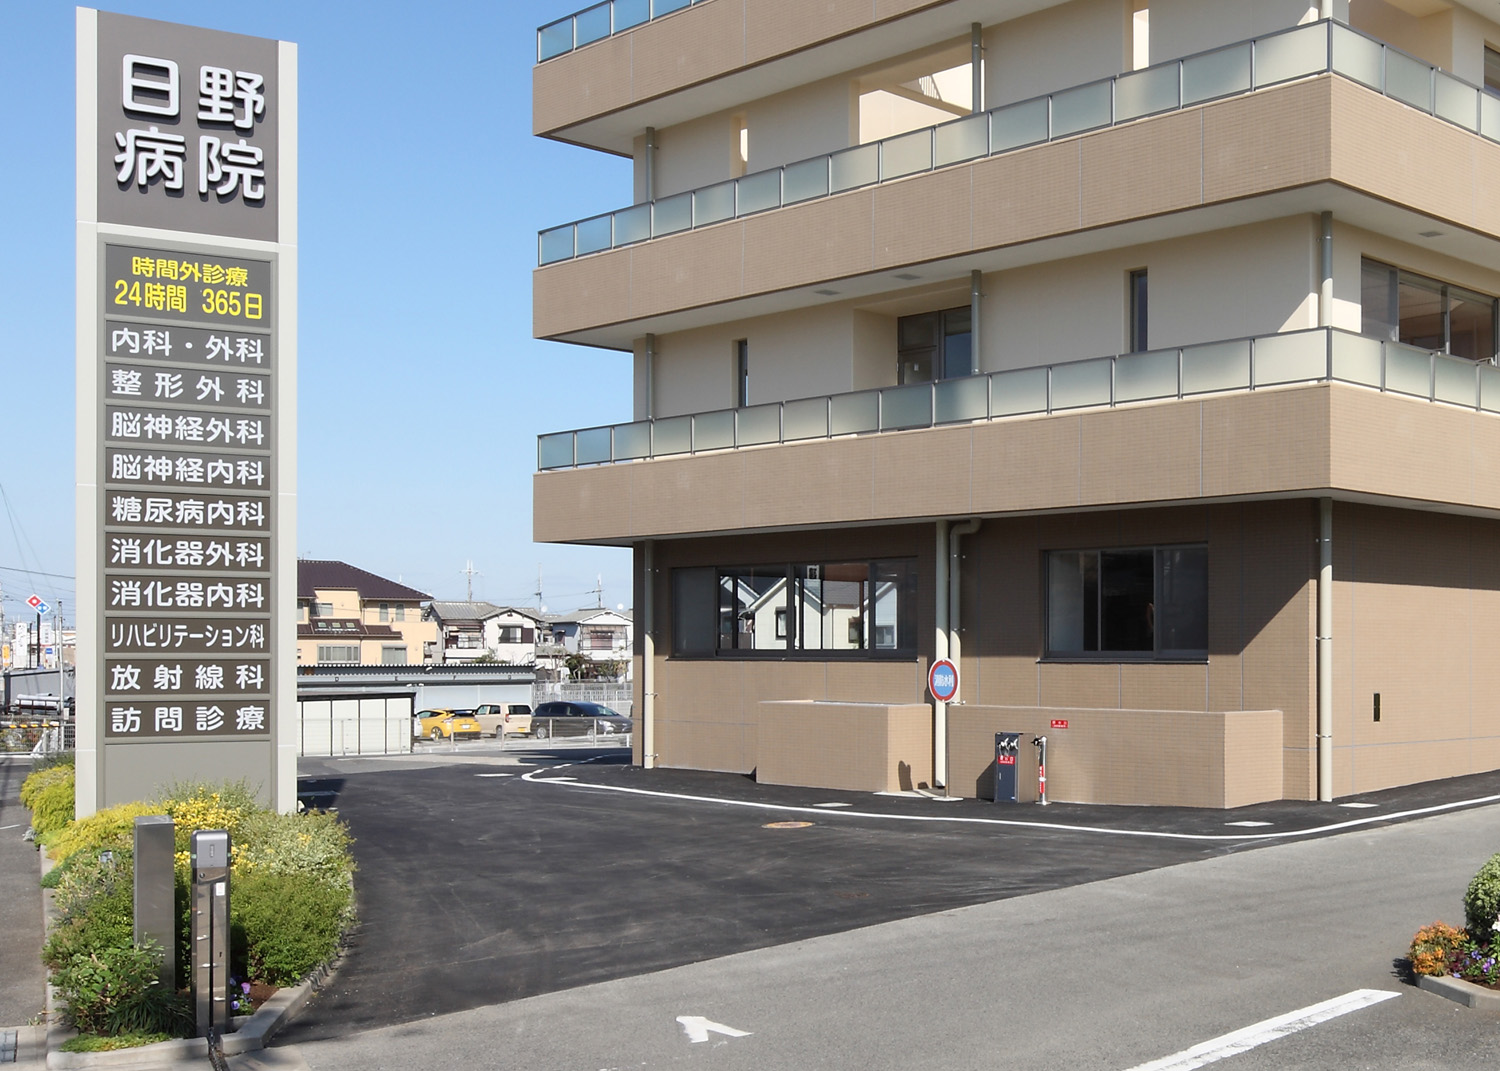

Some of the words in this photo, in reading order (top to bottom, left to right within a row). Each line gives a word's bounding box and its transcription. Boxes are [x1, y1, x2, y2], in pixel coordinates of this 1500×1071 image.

[122, 54, 265, 129] 日野
[114, 127, 265, 200] 病院
[132, 256, 248, 287] 時間外診療
[114, 279, 187, 313] 24時間
[202, 288, 262, 320] 365日
[111, 327, 264, 364] 内科・外科
[111, 369, 265, 405] 整形外科
[111, 411, 265, 446] 脳神経外科
[111, 454, 265, 486] 脳神経内科
[111, 496, 265, 527] 糖尿病内科
[111, 538, 264, 568] 消化器外科
[111, 580, 264, 608] 消化器内科
[111, 623, 265, 649] リハビリテーション科
[111, 664, 264, 691] 放射線科
[111, 705, 265, 733] 訪問診療
